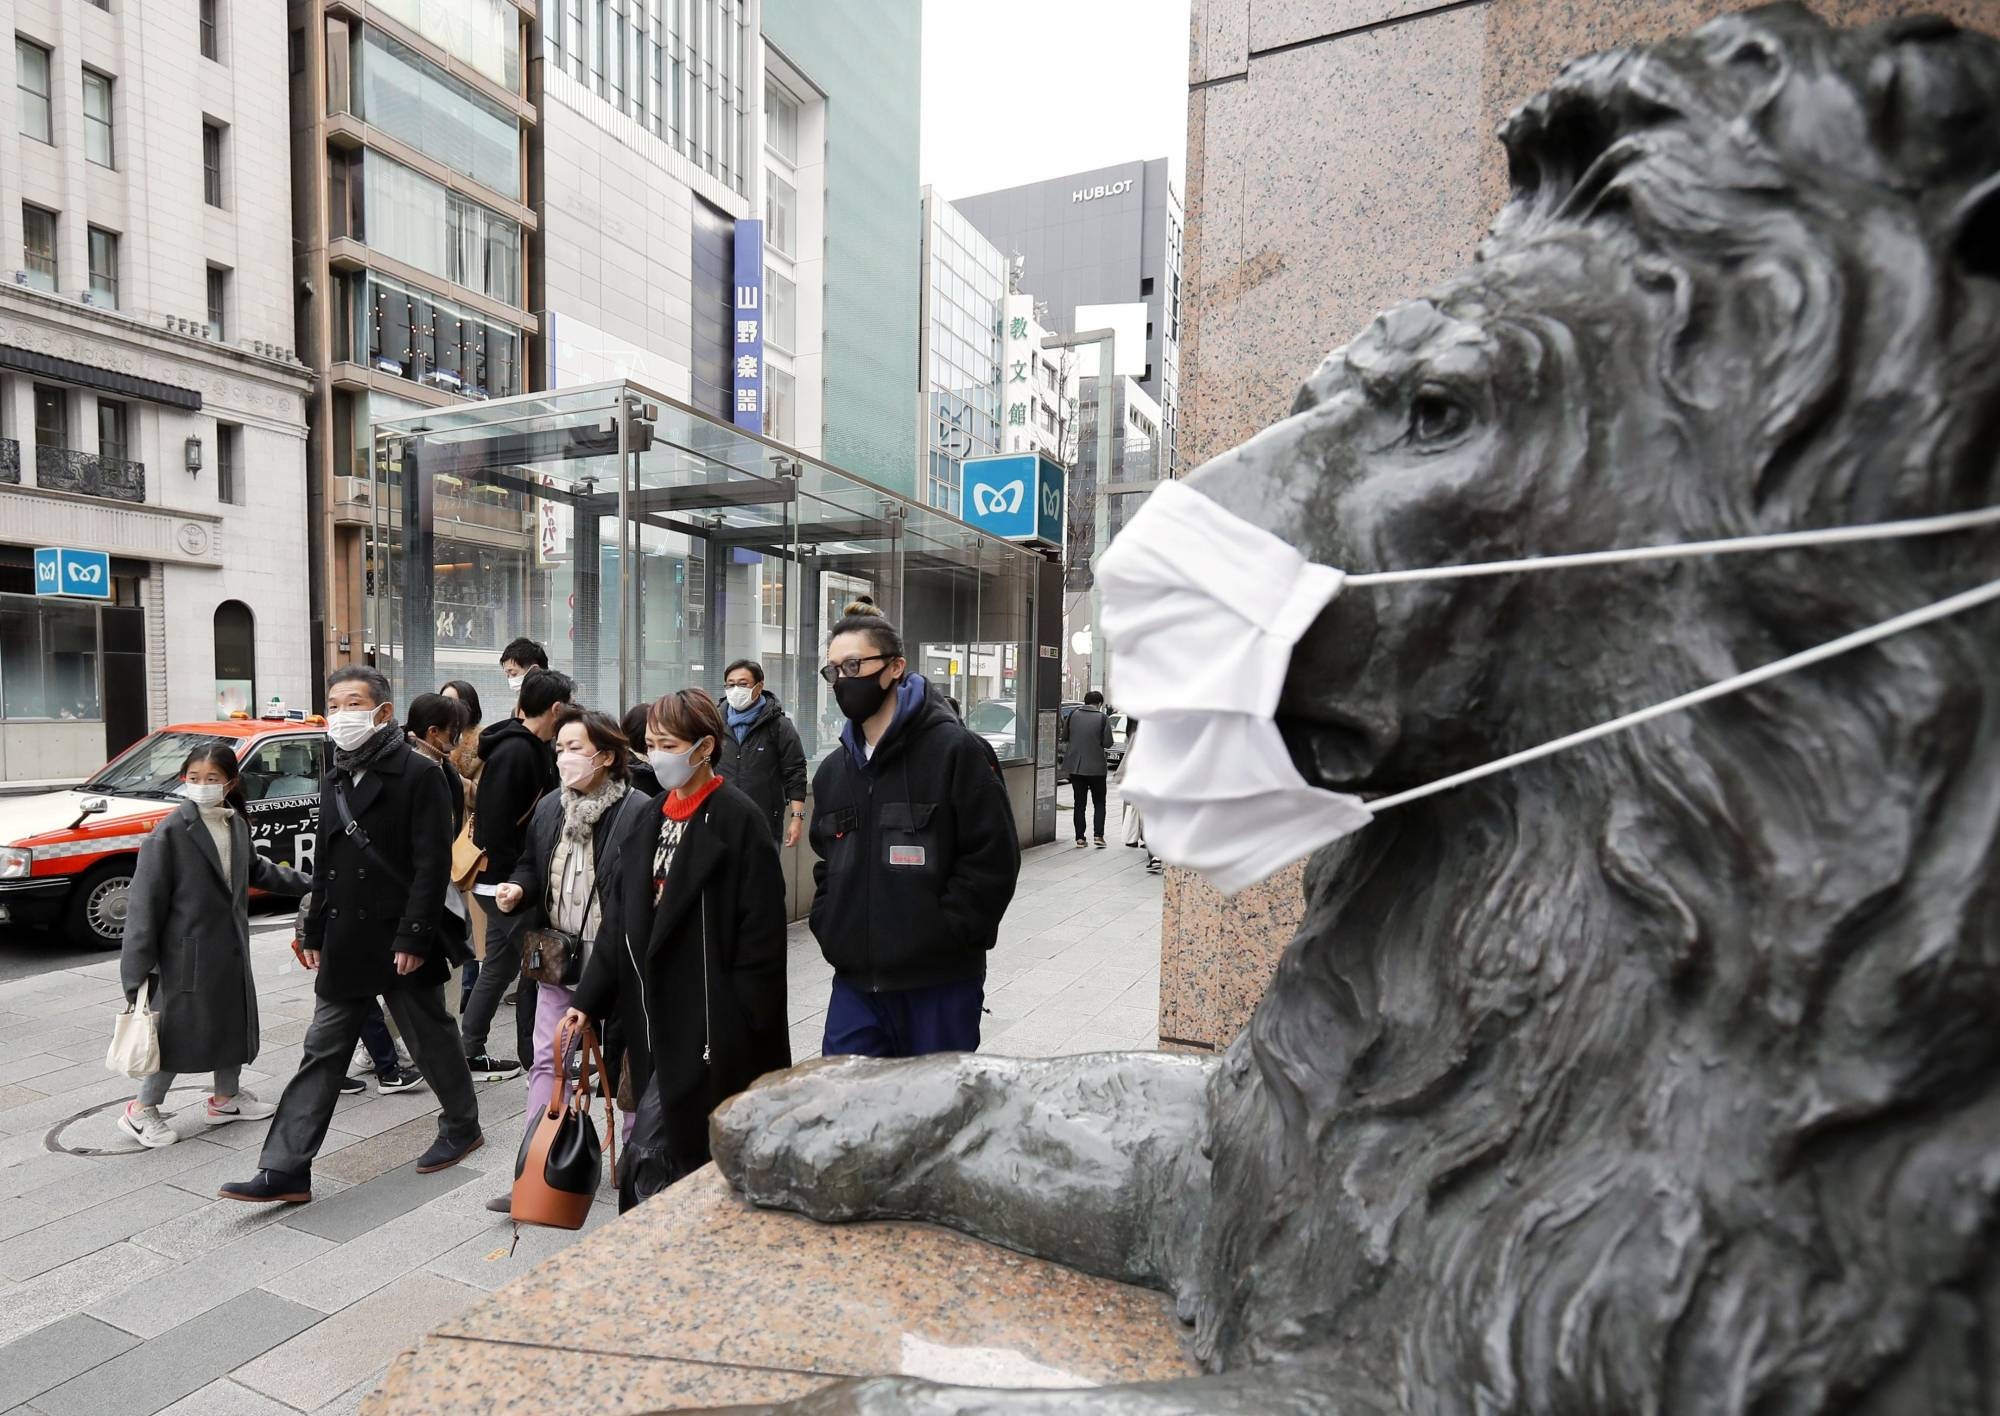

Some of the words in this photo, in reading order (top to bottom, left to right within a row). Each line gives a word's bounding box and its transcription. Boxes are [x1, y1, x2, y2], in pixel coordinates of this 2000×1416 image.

[1072, 179, 1134, 202] HUBLOT
[737, 286, 758, 412] 山野楽器
[1008, 316, 1028, 426] 教文館
